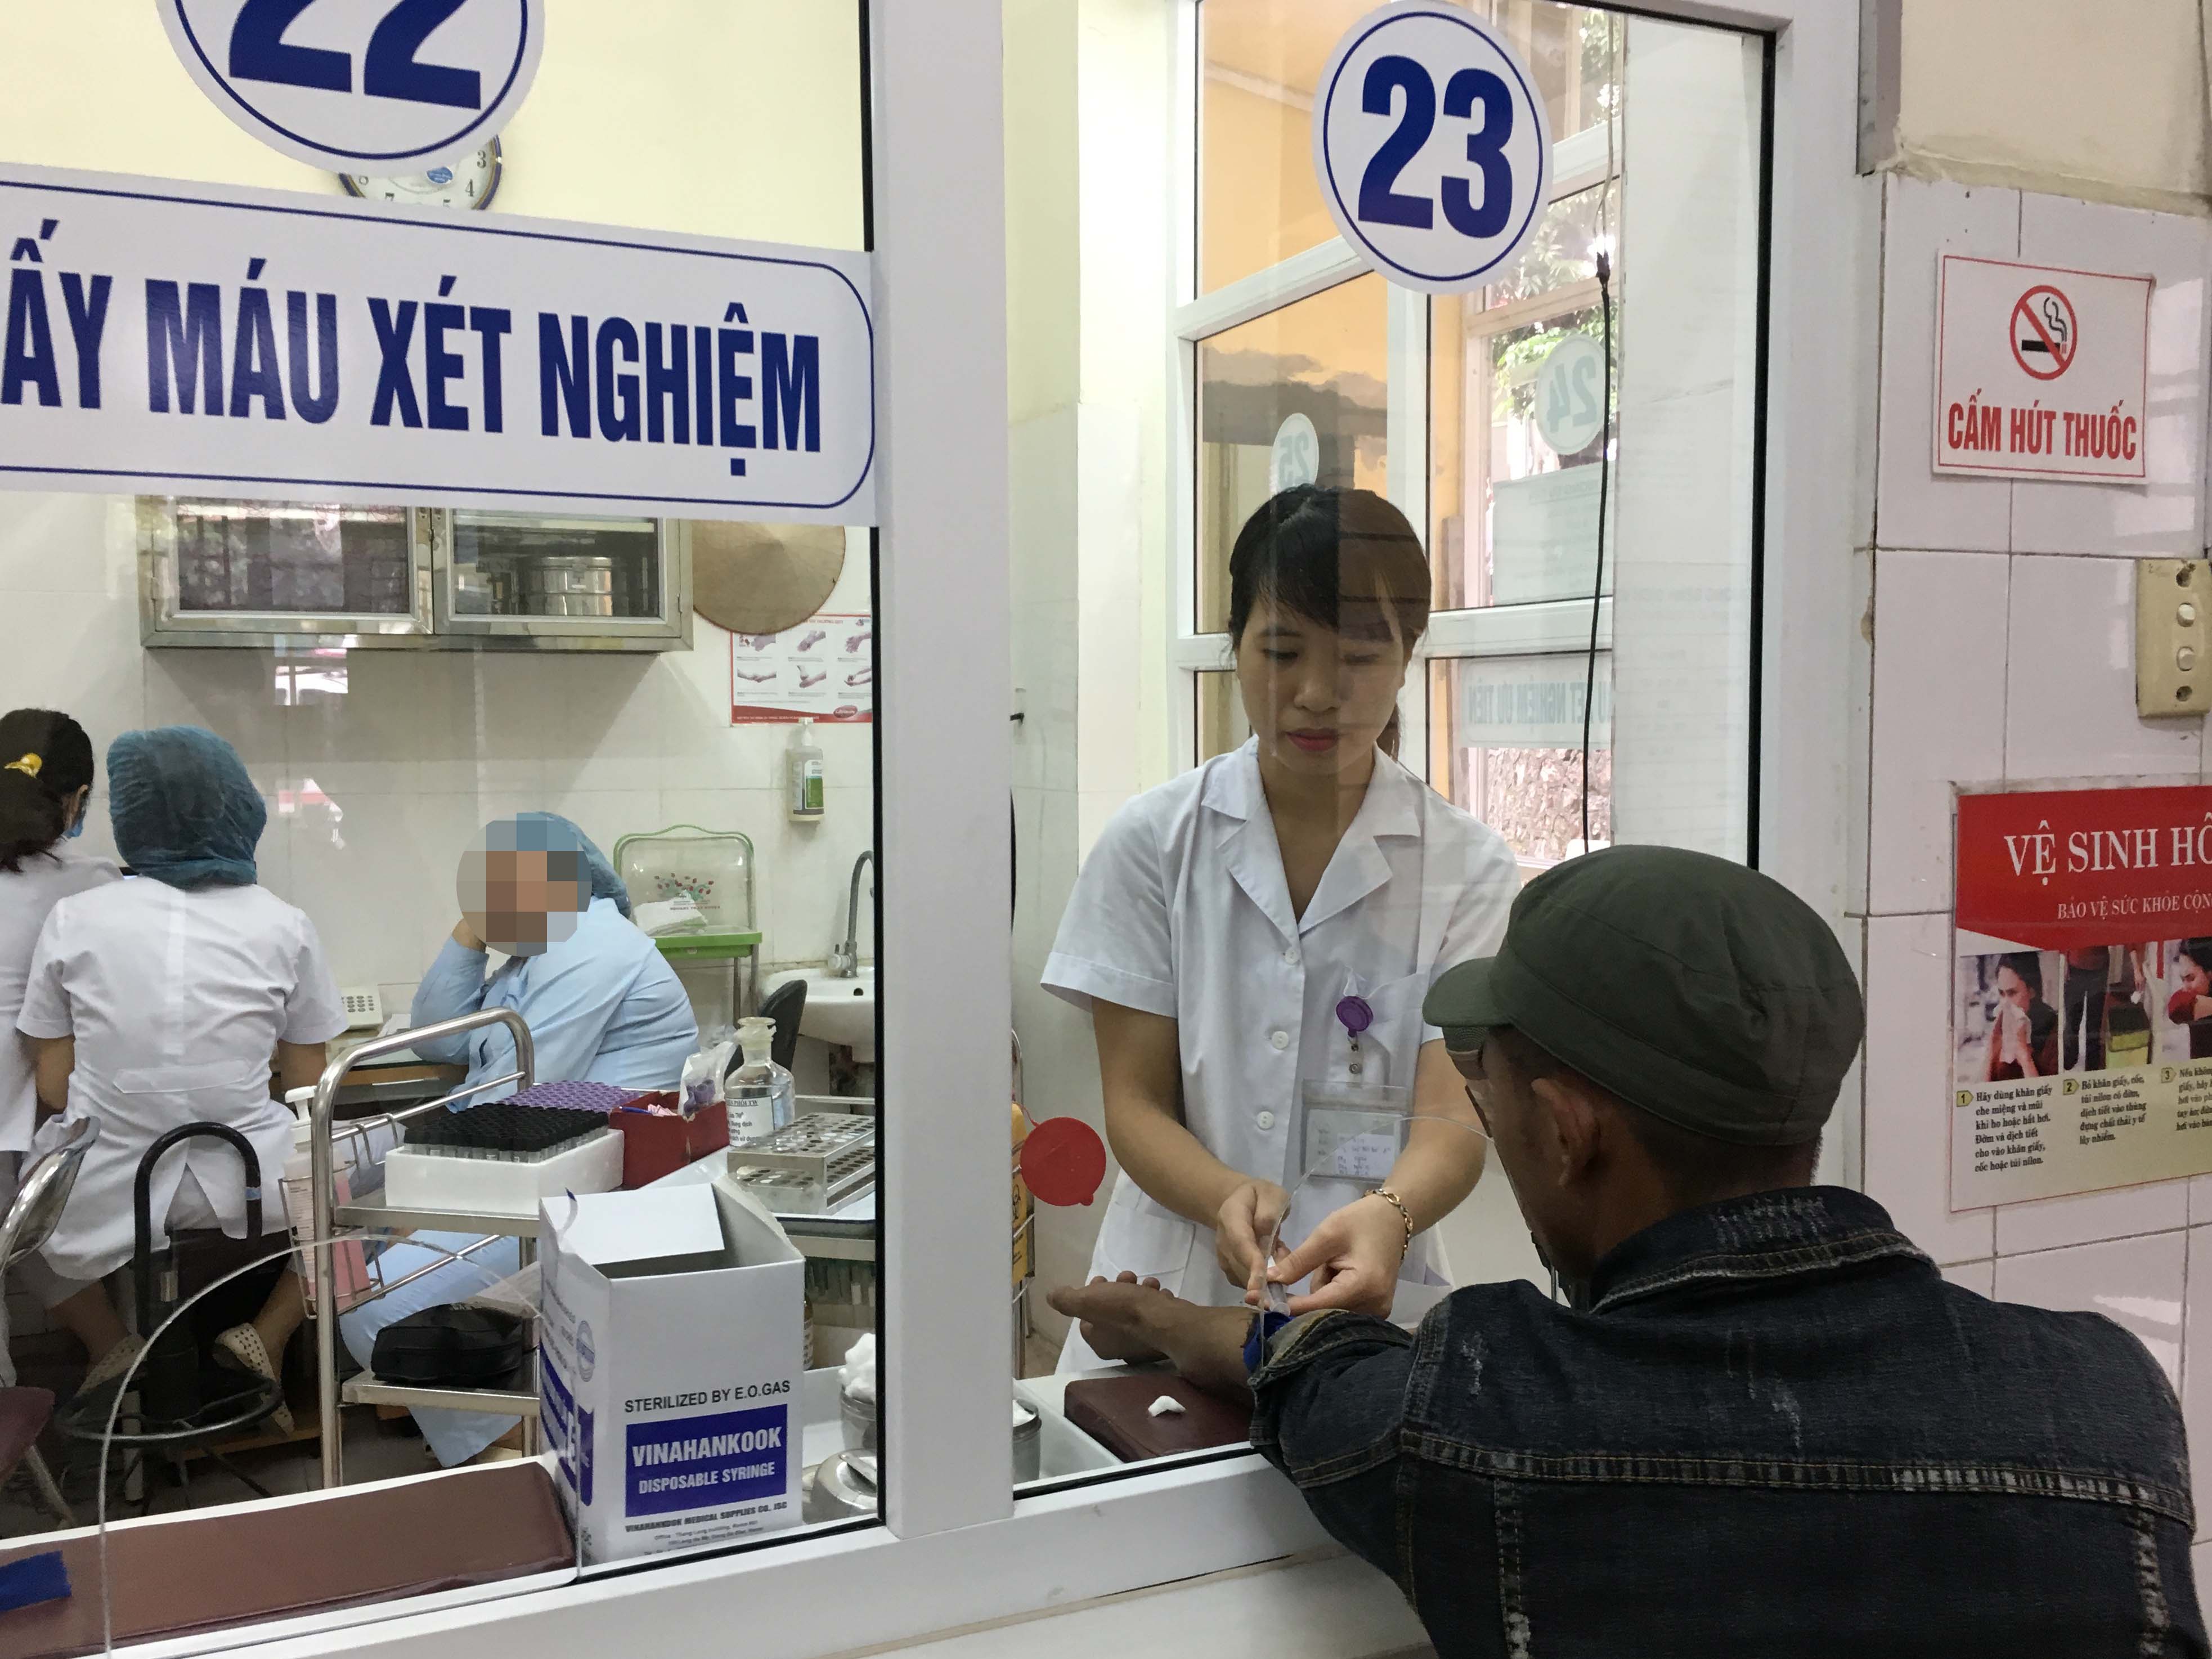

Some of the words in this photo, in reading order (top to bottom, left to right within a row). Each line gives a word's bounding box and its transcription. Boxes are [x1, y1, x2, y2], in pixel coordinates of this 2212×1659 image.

[1358, 55, 1513, 238] 23
[477, 150, 486, 168] 3
[465, 179, 474, 197] 4
[1, 219, 112, 409] ẤY
[145, 257, 339, 424] MÁU
[367, 276, 512, 433] XÉT
[538, 302, 820, 477] NGHIỆM
[1949, 388, 2002, 452] CẤM
[2011, 400, 2057, 455] HÚT
[2063, 400, 2136, 460] THUỐC
[2004, 820, 2056, 886] VỆ
[2068, 828, 2159, 873] SINH
[2058, 896, 2087, 919] BẢO
[2090, 896, 2108, 920] VỆ
[2112, 894, 2138, 914] SỨC
[2183, 889, 2212, 913] CỘN
[2165, 1070, 2170, 1080] 3
[1976, 1092, 1991, 1102] Hãy
[1994, 1090, 2013, 1100] dùng
[2036, 1083, 2052, 1097] giấy
[2067, 1082, 2072, 1092] 2
[1961, 1093, 1965, 1104] 1
[1976, 1106, 1990, 1115] che
[1992, 1104, 2016, 1115] miệng
[2017, 1102, 2027, 1111] và
[1976, 1120, 1989, 1130] khi
[1991, 1119, 2000, 1128] ho
[2003, 1118, 2021, 1128] hoặc
[1995, 1132, 2004, 1141] và
[2007, 1130, 2023, 1142] dịch
[2025, 1127, 2038, 1137] tiết
[1975, 1149, 1989, 1158] cho
[1991, 1146, 2005, 1156] vào
[1975, 1161, 1988, 1172] cốc
[1990, 1160, 2008, 1171] hoặc
[625, 1392, 707, 1413] STERILIZED
[712, 1388, 731, 1404] BY
[735, 1380, 791, 1400] E.O.GAS
[632, 1427, 782, 1467] VINAHANKOOK
[639, 1469, 719, 1494] DISPOSABLE
[723, 1461, 775, 1485] SYRINGE
[720, 1507, 756, 1519] SUPPLIES
